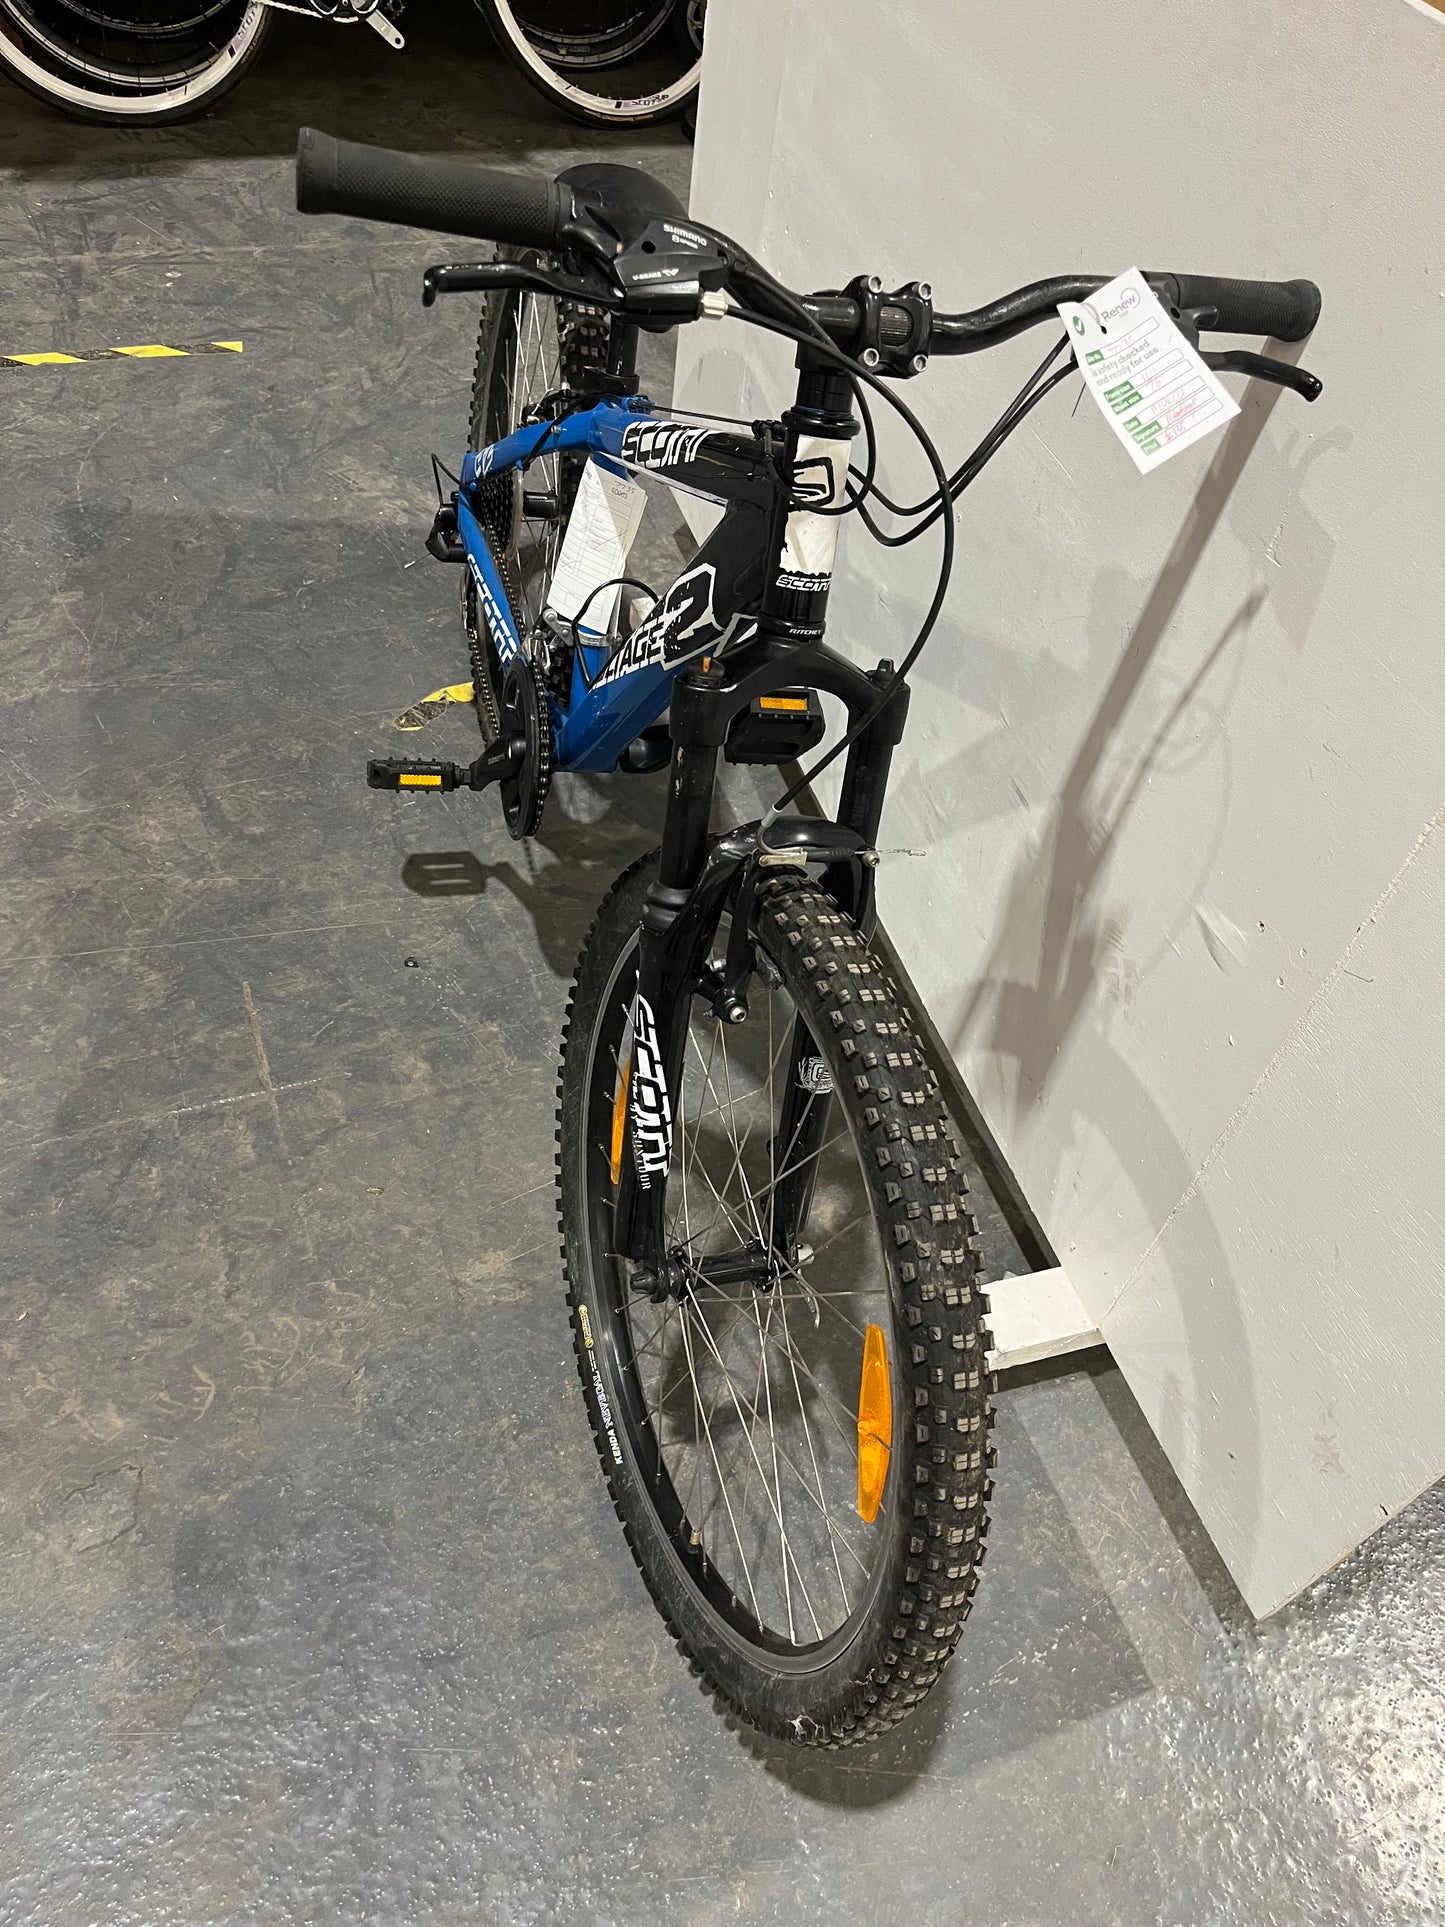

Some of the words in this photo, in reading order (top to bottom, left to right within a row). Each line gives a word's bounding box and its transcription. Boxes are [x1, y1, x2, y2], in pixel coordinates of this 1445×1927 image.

[663, 223, 708, 247] SHIMANO
[1101, 294, 1138, 322] Renew
[1097, 358, 1119, 377] safety
[1116, 339, 1150, 364] checked
[1109, 364, 1132, 382] ready
[1129, 355, 1144, 368] for
[1143, 347, 1159, 360] use
[634, 993, 673, 1179] SCOTT
[592, 1370, 614, 1430] NEVEGAL
[608, 1428, 624, 1465] KENDA
